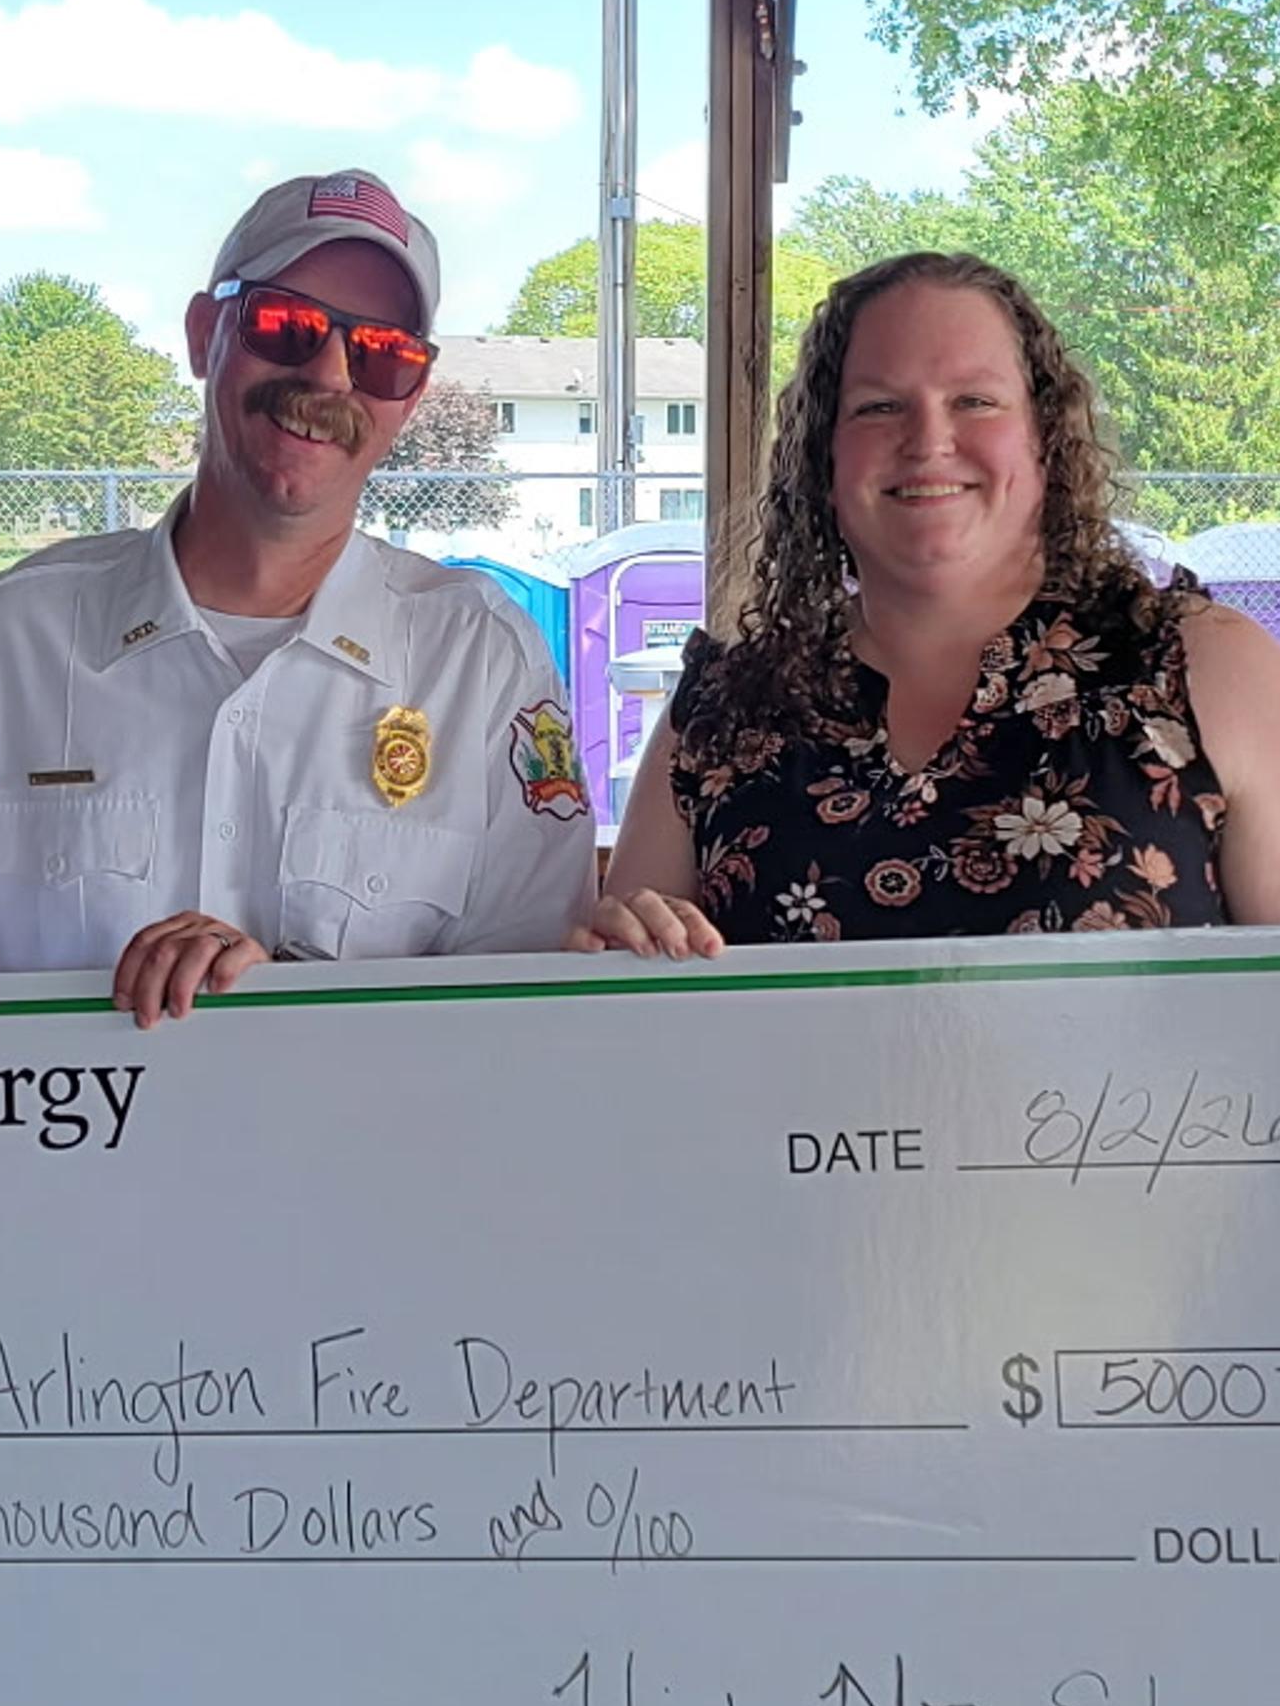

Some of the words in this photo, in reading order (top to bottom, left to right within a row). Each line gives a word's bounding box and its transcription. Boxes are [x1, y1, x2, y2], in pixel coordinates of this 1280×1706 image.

[787, 1129, 925, 1174] DATE
[311, 1327, 410, 1428] Fire
[454, 1336, 797, 1476] Department
[1000, 1353, 1044, 1429] $
[234, 1479, 437, 1554] Dollars
[586, 1466, 694, 1575] 0/100
